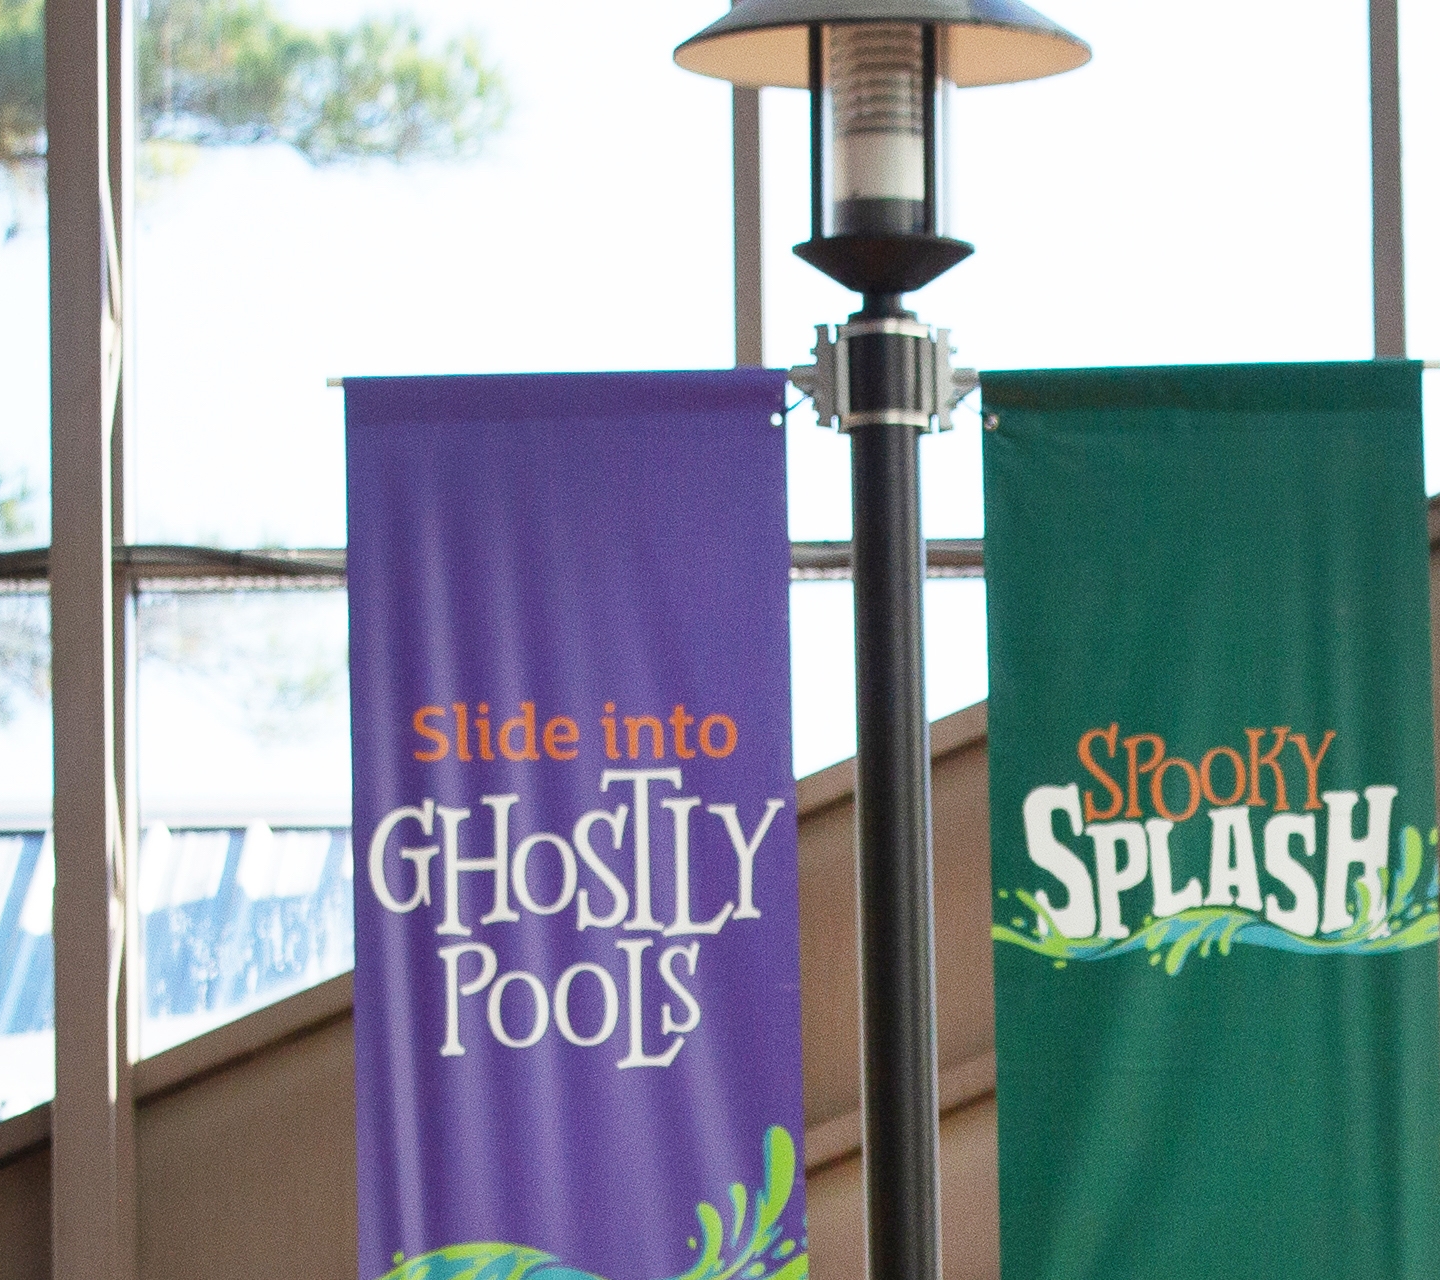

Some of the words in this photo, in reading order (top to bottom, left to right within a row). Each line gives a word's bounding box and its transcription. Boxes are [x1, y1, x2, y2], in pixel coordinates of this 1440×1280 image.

[412, 701, 580, 761] Slide
[600, 701, 738, 759] into
[1077, 722, 1337, 822] SPOOKY
[368, 767, 785, 937] GHOSTLY
[1023, 782, 1398, 940] SPLASH
[438, 938, 701, 1069] POOLS
